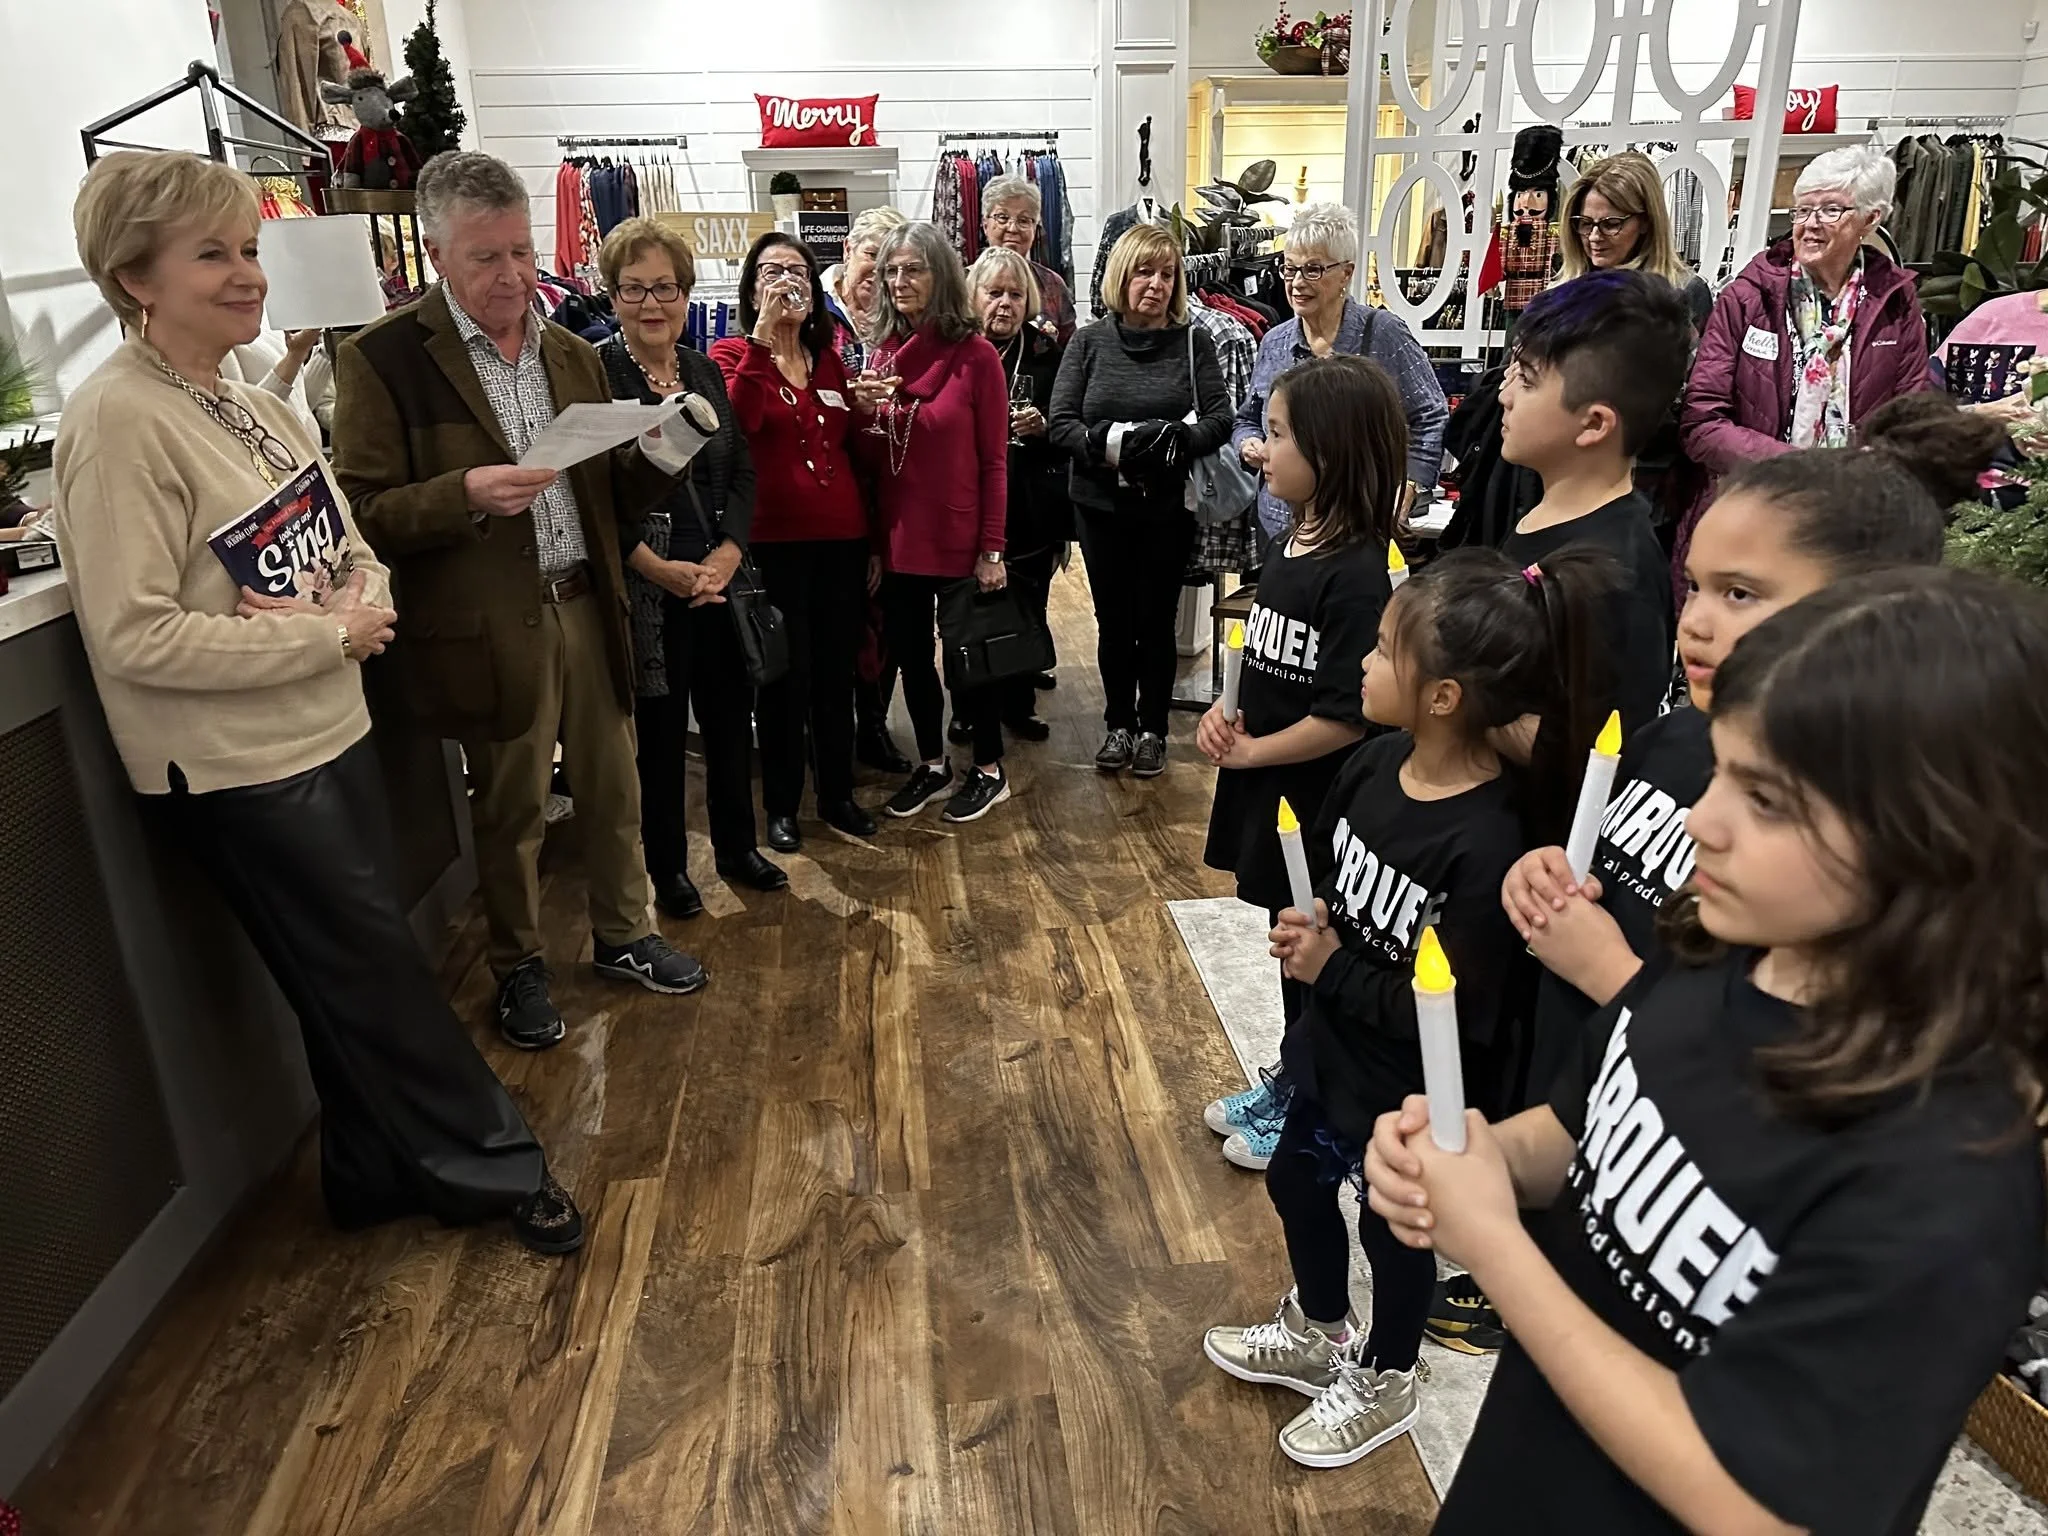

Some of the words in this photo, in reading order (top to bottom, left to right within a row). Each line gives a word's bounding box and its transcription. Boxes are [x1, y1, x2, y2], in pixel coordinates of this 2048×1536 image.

[766, 98, 869, 146] Merry
[1786, 88, 1821, 131] oy
[694, 217, 750, 254] SAXX
[800, 225, 849, 233] LIFE-CHANGING
[278, 525, 294, 544] look
[293, 519, 301, 532] up
[300, 505, 312, 524] and
[257, 506, 334, 592] Sing
[1244, 602, 1320, 671] RQUEE
[1617, 870, 1664, 907] produ
